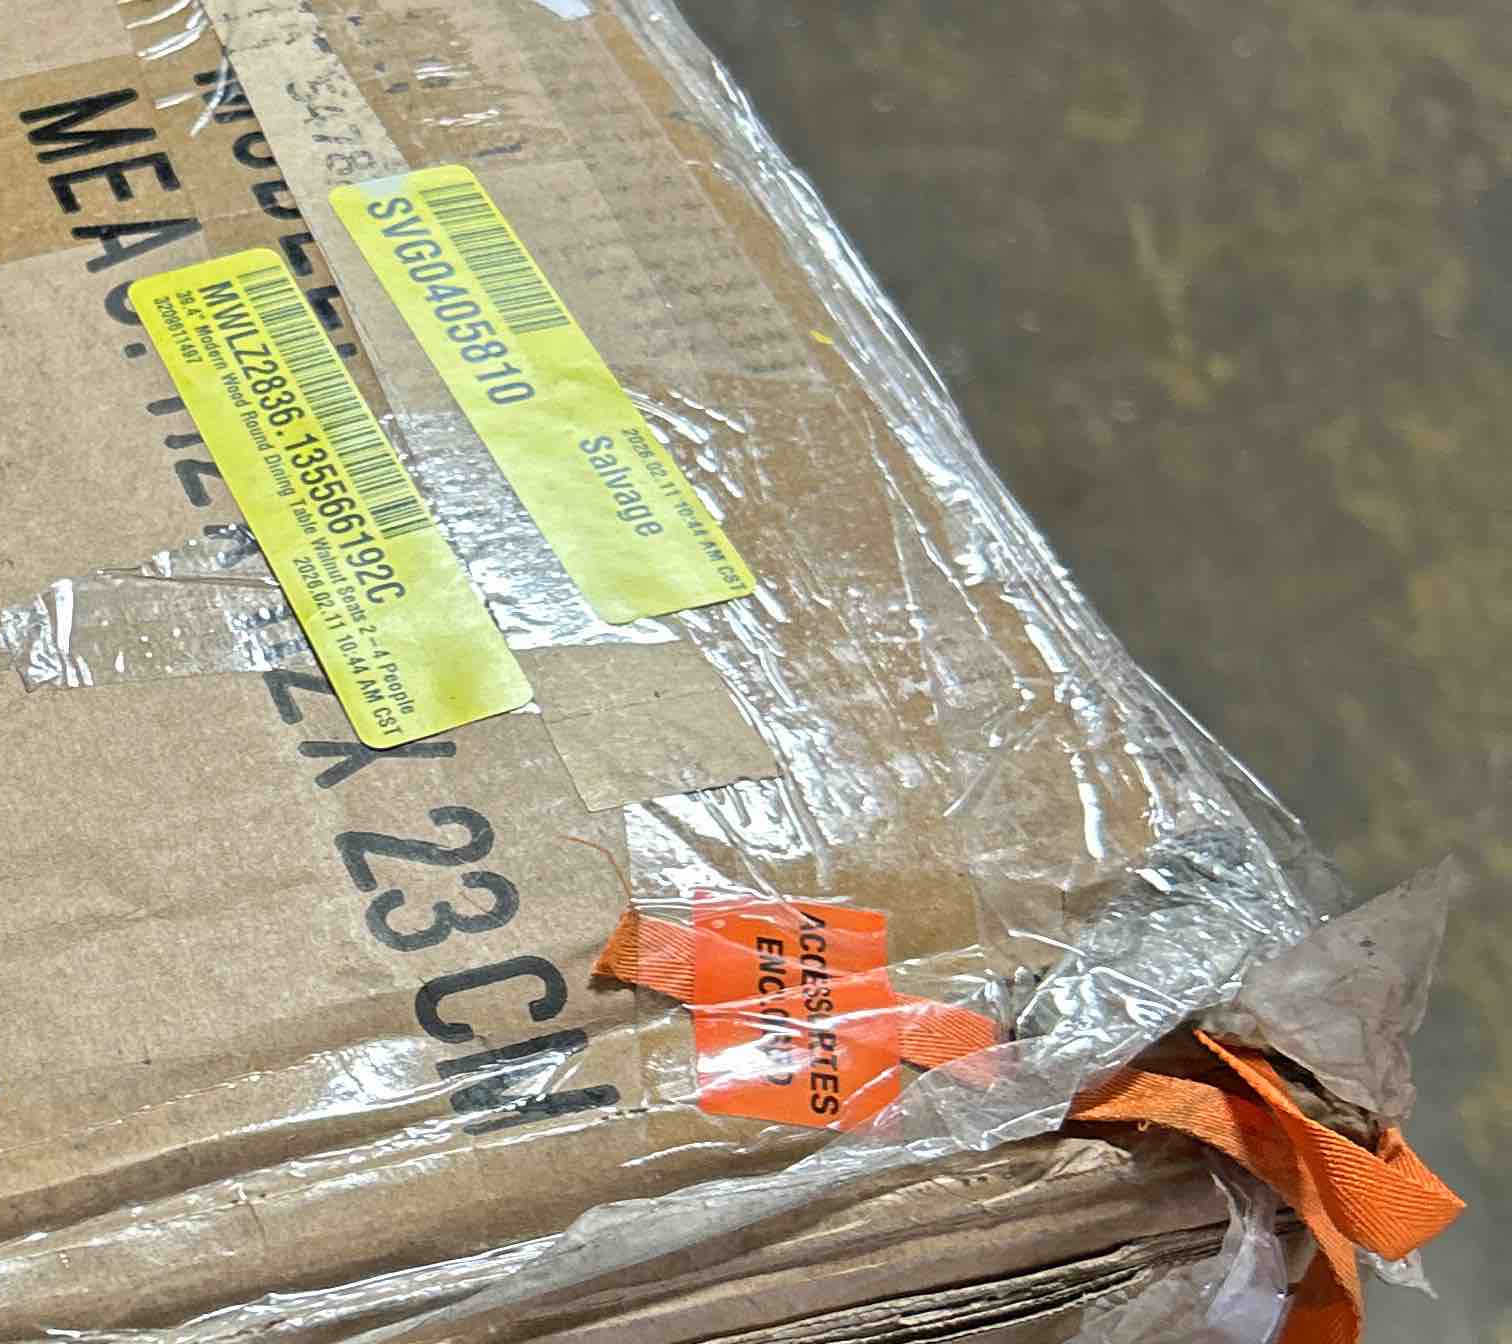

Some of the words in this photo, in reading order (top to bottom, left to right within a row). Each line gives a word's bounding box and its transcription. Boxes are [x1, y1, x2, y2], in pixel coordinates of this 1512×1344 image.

[367, 195, 535, 407] SVG0405810
[195, 324, 229, 371] Modern
[221, 371, 249, 408] Wood
[242, 410, 272, 452] Round
[262, 452, 297, 498] Dining
[290, 498, 318, 535] Table
[311, 536, 346, 584] Walnut
[338, 584, 367, 623] Seats
[376, 662, 417, 716] People
[203, 279, 407, 602] MWLZ2836.135566192C
[578, 434, 664, 538] Salvage
[333, 633, 370, 675] 10:44
[356, 676, 385, 704] AM
[371, 705, 403, 738] CST
[799, 910, 839, 1117] ACCESSRIES
